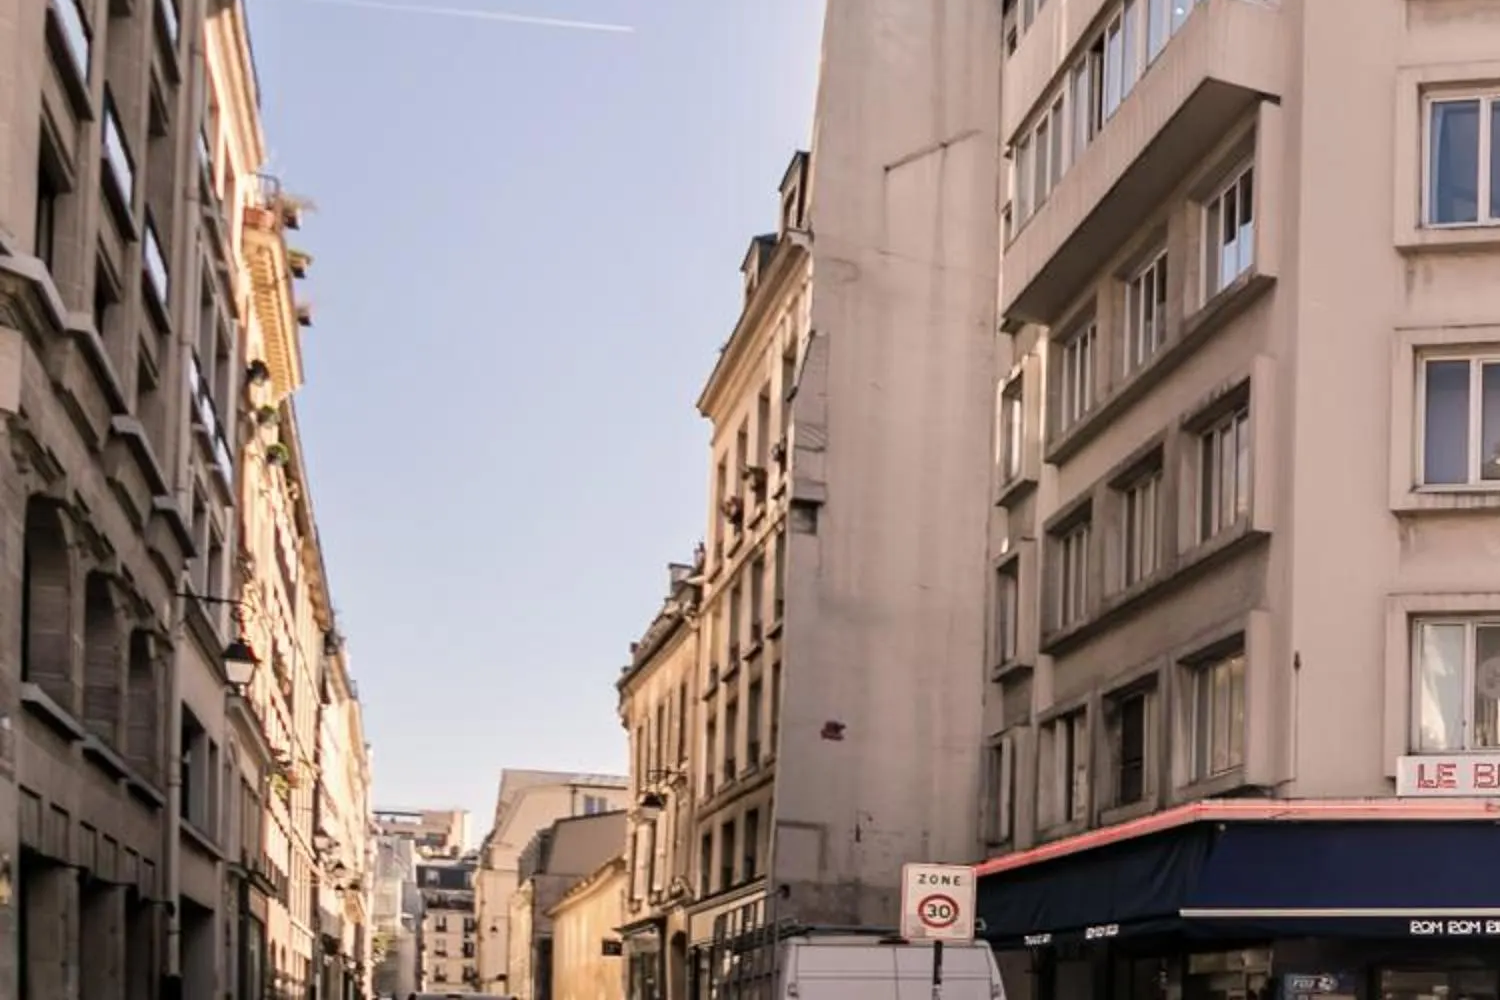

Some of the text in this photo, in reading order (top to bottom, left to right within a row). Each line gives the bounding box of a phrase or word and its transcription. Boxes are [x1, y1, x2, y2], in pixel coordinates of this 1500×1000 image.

[1417, 763, 1457, 789] LE
[918, 873, 961, 886] ZONE
[927, 904, 951, 919] 30
